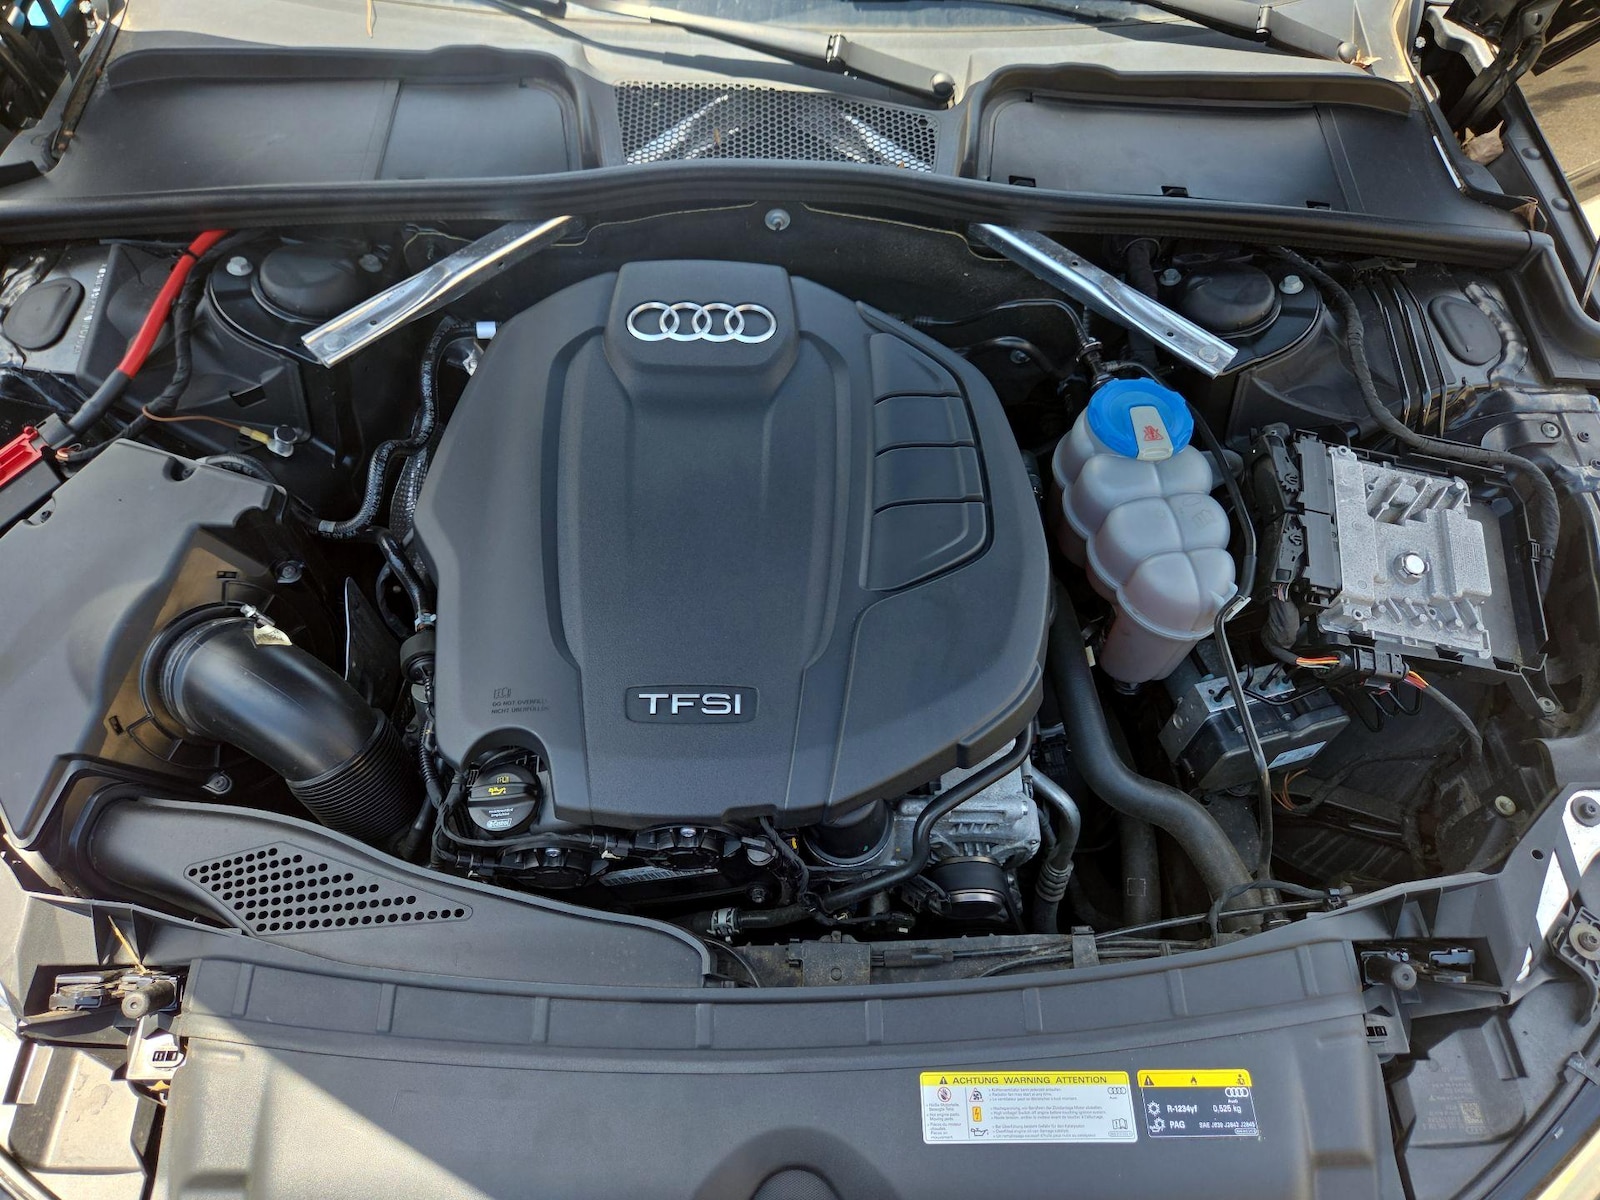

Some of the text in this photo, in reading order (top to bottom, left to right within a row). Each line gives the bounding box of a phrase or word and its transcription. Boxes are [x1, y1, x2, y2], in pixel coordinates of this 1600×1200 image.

[638, 693, 742, 715] TFSI
[1004, 1076, 1051, 1084] WARNING
[1056, 1076, 1108, 1084] ATTENTION
[1233, 1104, 1242, 1114] kg
[1169, 1120, 1187, 1130] PAG
